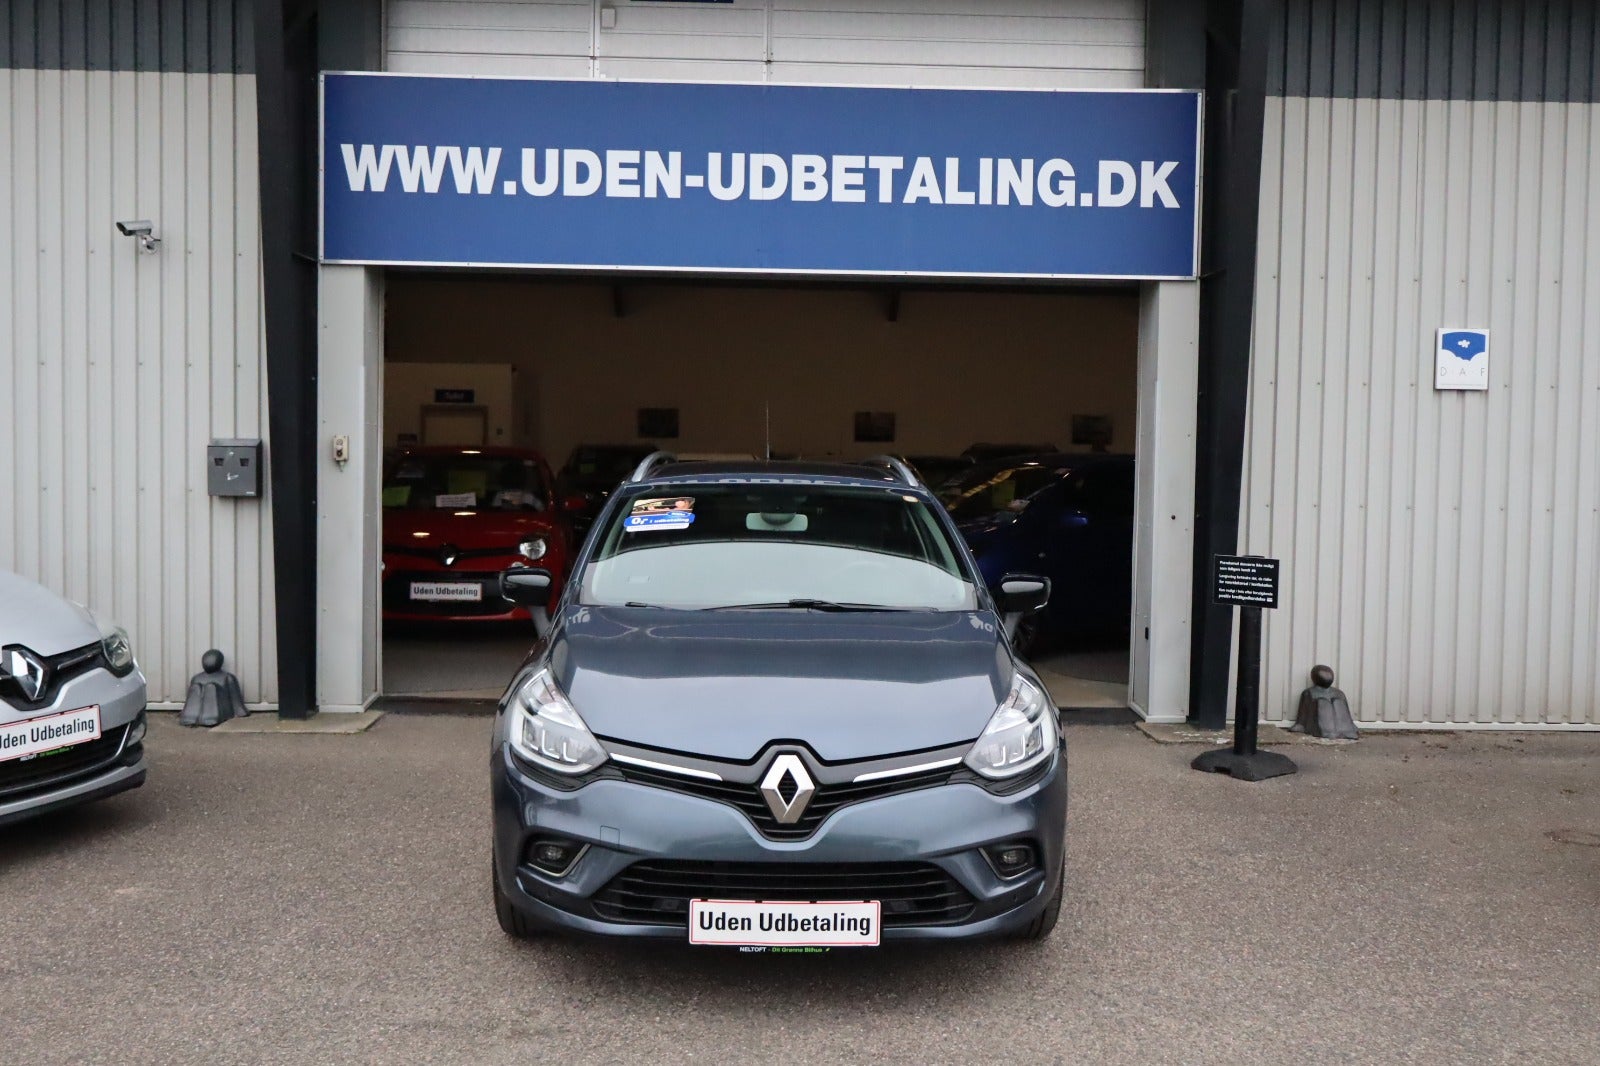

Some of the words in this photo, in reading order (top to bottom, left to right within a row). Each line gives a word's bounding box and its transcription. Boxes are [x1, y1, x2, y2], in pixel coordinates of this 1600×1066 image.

[340, 143, 1181, 209] WWW.UDEN-UDBETALING.DK
[413, 587, 434, 595] Uden
[436, 588, 478, 597] Udbetaling
[31, 718, 94, 742] Udbetaling
[699, 911, 752, 931] Uden
[759, 913, 871, 936] Udbetaling
